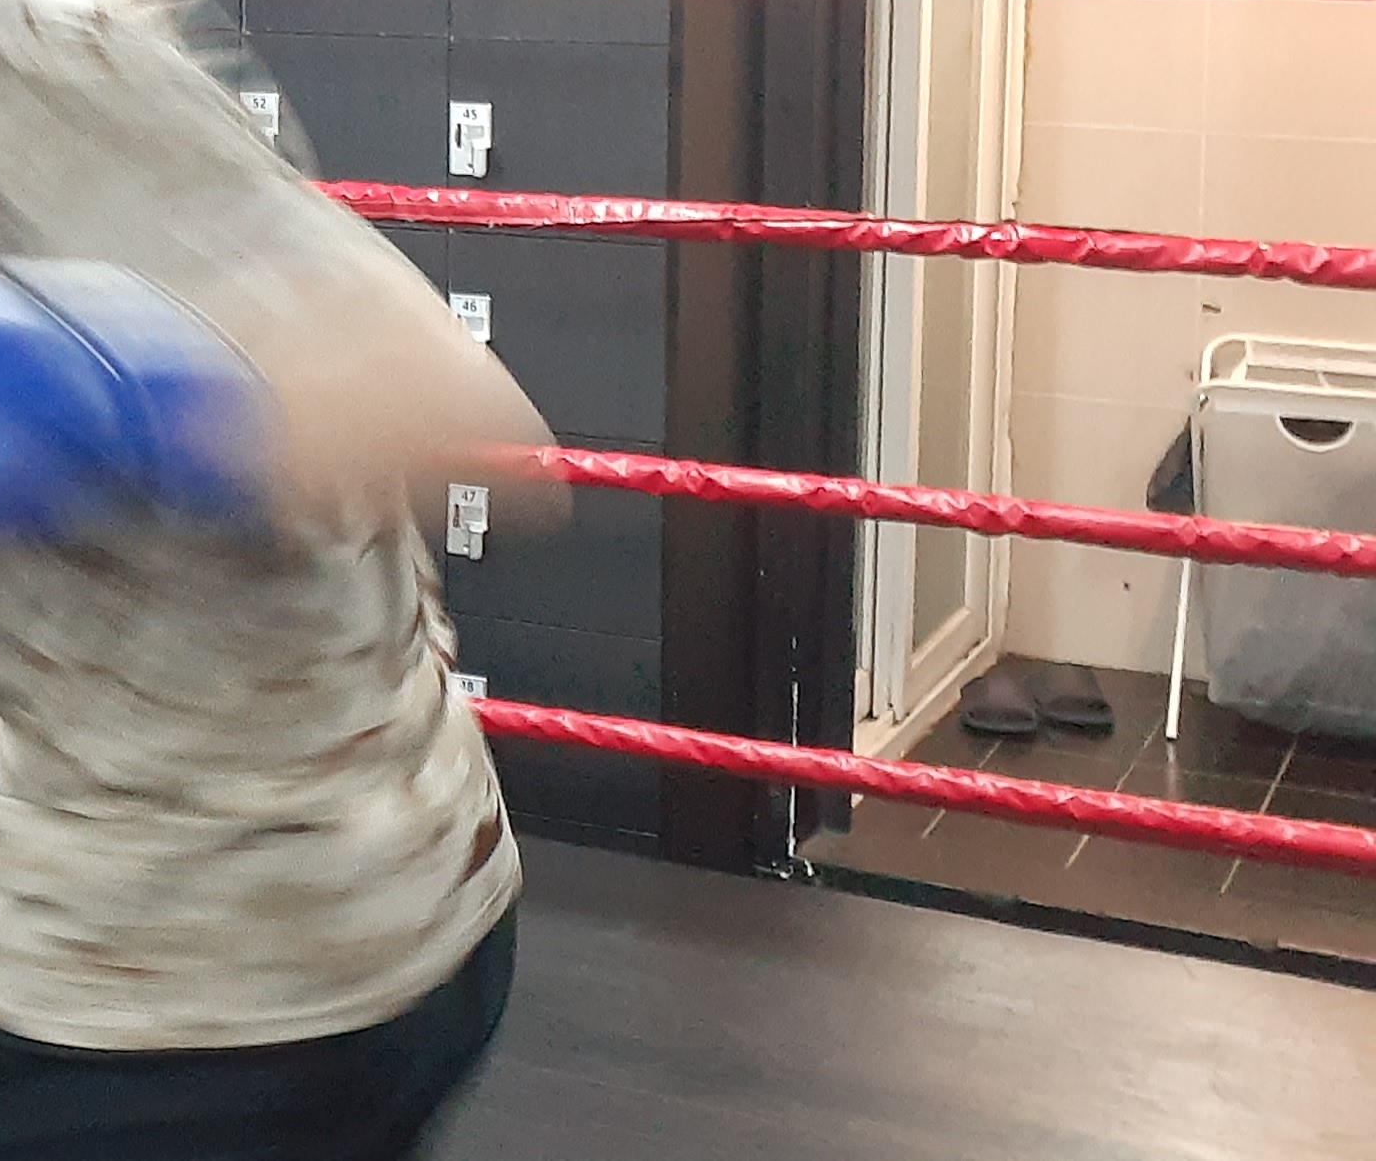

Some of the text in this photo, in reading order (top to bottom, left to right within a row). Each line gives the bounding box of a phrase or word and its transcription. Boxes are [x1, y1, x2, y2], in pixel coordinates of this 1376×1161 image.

[252, 97, 266, 110] 52
[462, 108, 478, 120] 45
[461, 301, 477, 312] 46
[461, 490, 476, 502] 47
